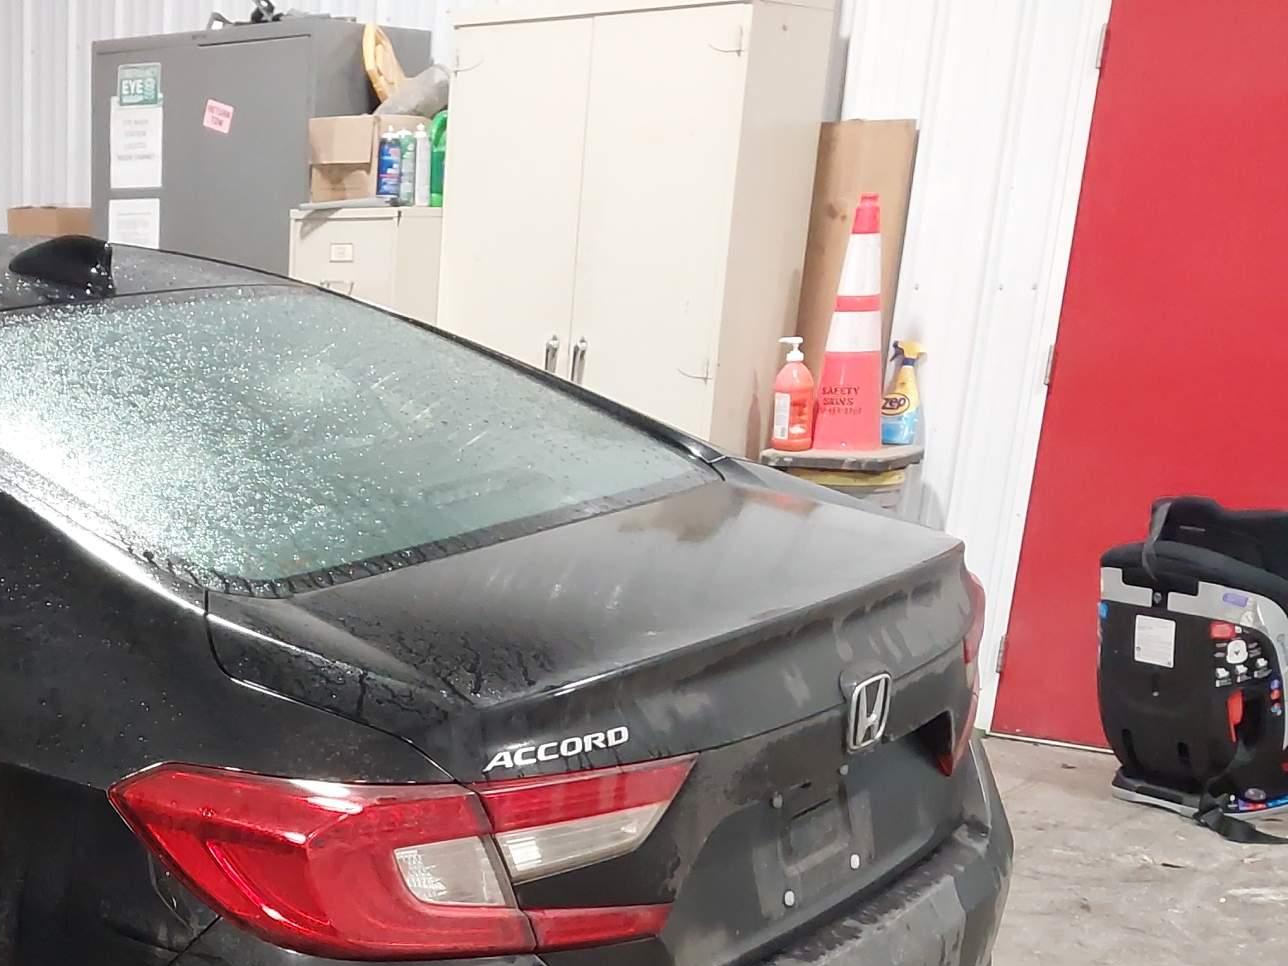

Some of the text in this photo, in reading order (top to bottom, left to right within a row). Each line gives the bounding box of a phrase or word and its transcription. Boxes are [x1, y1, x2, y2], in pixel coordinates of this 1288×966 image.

[122, 79, 143, 94] EYE
[822, 386, 860, 395] SAFETY
[482, 726, 629, 773] ACCORD
